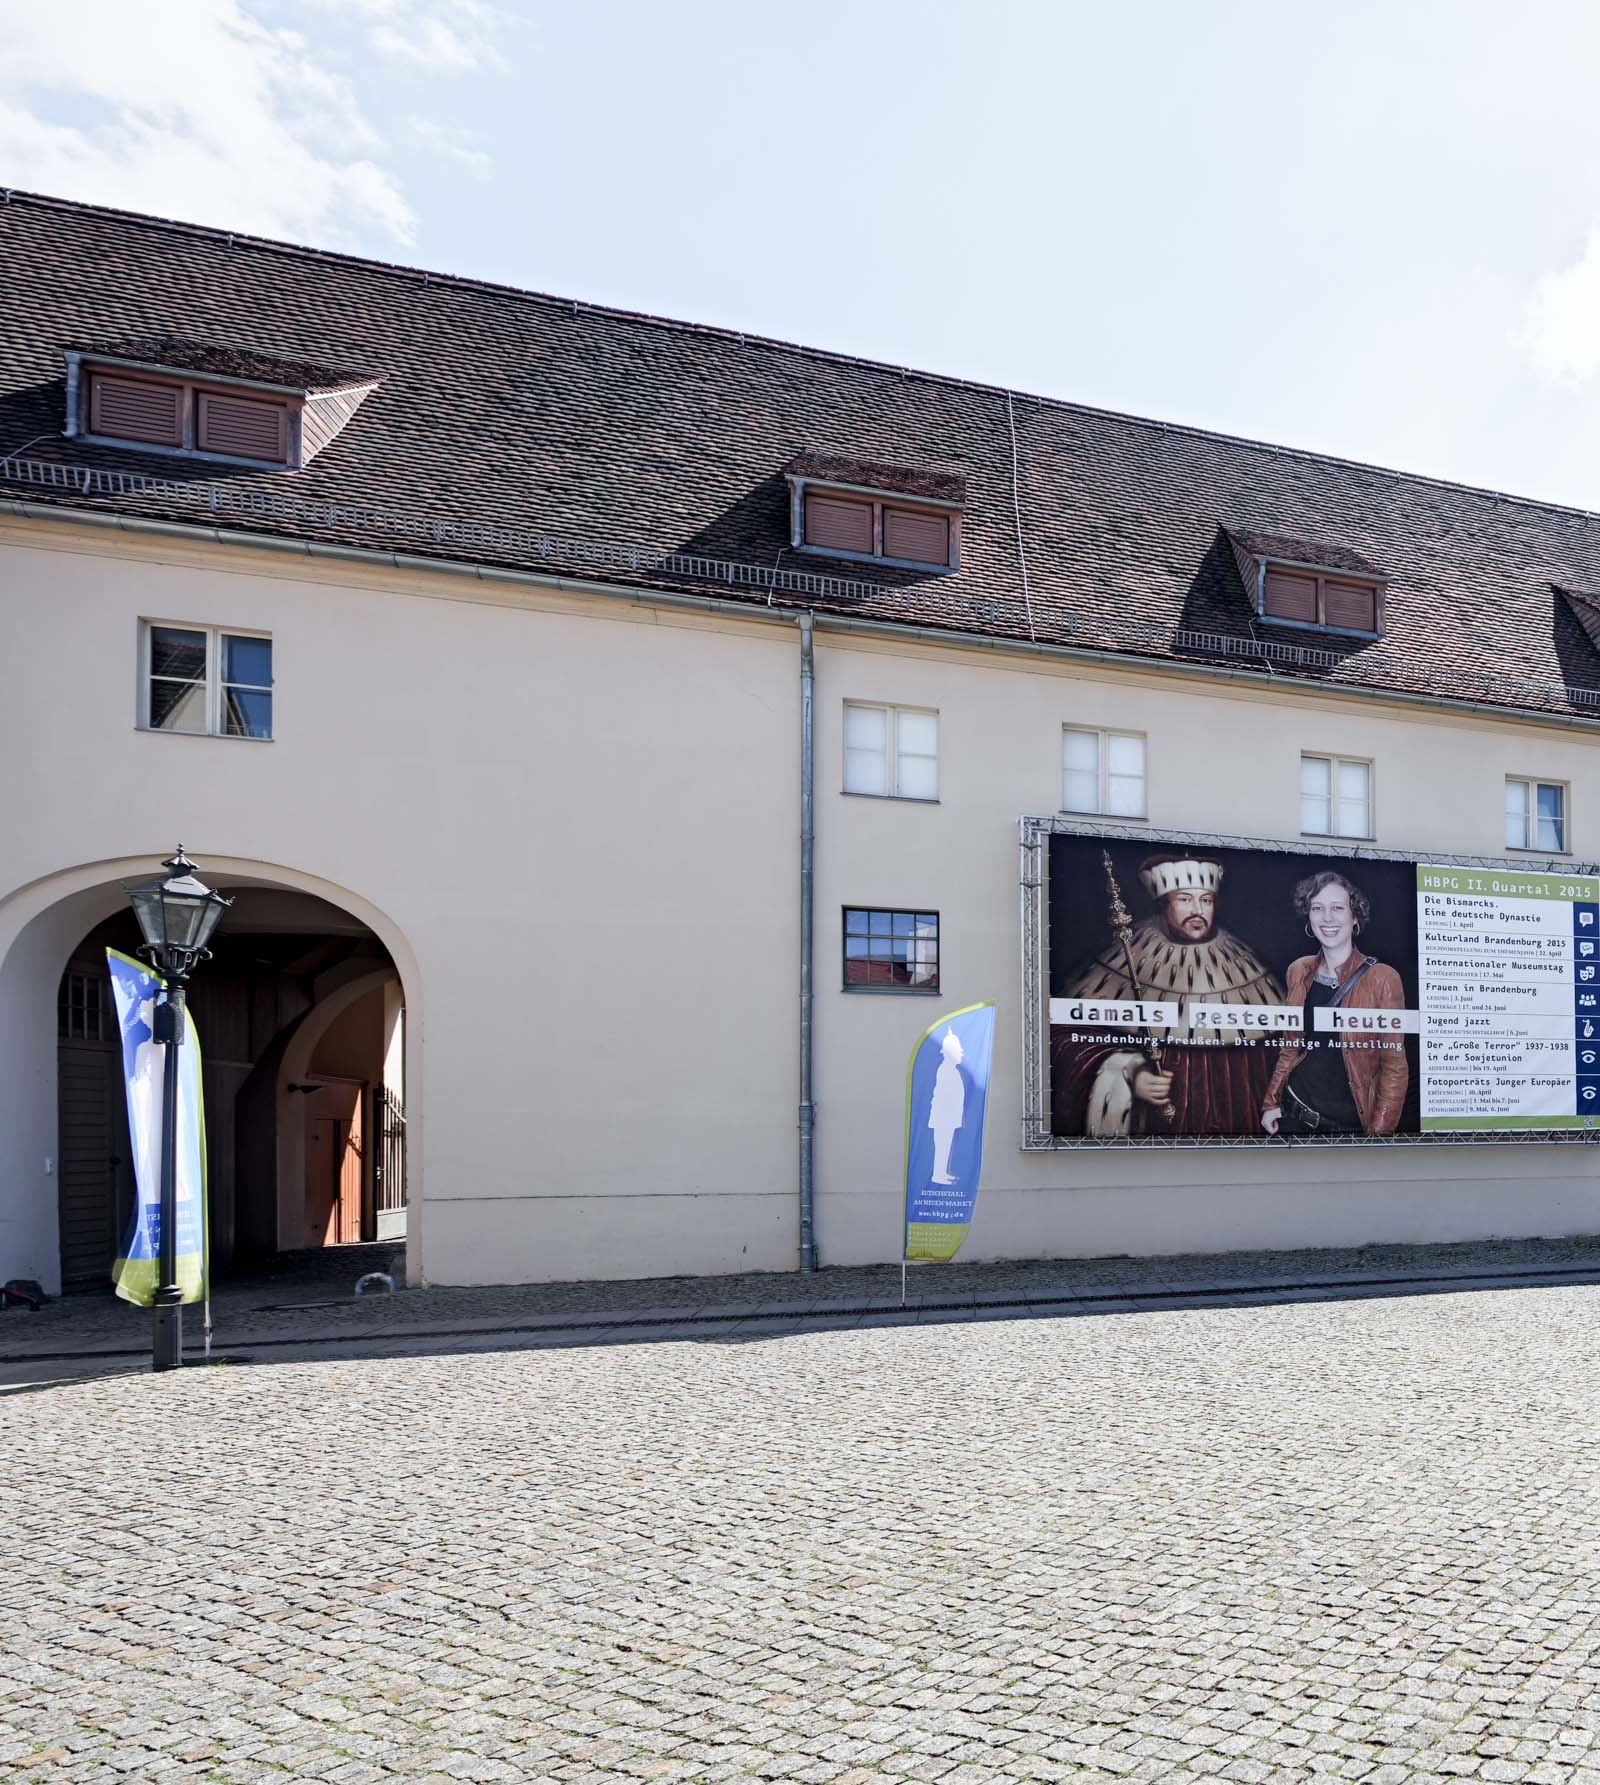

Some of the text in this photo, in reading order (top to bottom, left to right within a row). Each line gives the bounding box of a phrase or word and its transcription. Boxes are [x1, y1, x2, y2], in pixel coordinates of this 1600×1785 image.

[1424, 876, 1591, 898] HBPG II. Quartal 2015
[1424, 896, 1499, 908] Die Bismarcks.
[1425, 908, 1541, 922] Eine deutsche Dynastie
[1425, 932, 1566, 948] Kulturland Brandenburg 2015
[1426, 958, 1564, 973] Internationaler Museumstag
[1426, 983, 1537, 997] Frauen in Brandenburg
[1070, 1003, 1402, 1029] damals gestern heute
[1427, 1016, 1491, 1027] Jugend jazzt
[1071, 1033, 1403, 1051] Brandenburg-Preußen: Die ständige Ausstellung
[1427, 1041, 1444, 1049] Der
[1427, 1052, 1522, 1064] in der Sowjetunion
[1427, 1077, 1571, 1087] Fotoporträts Junger Europäer
